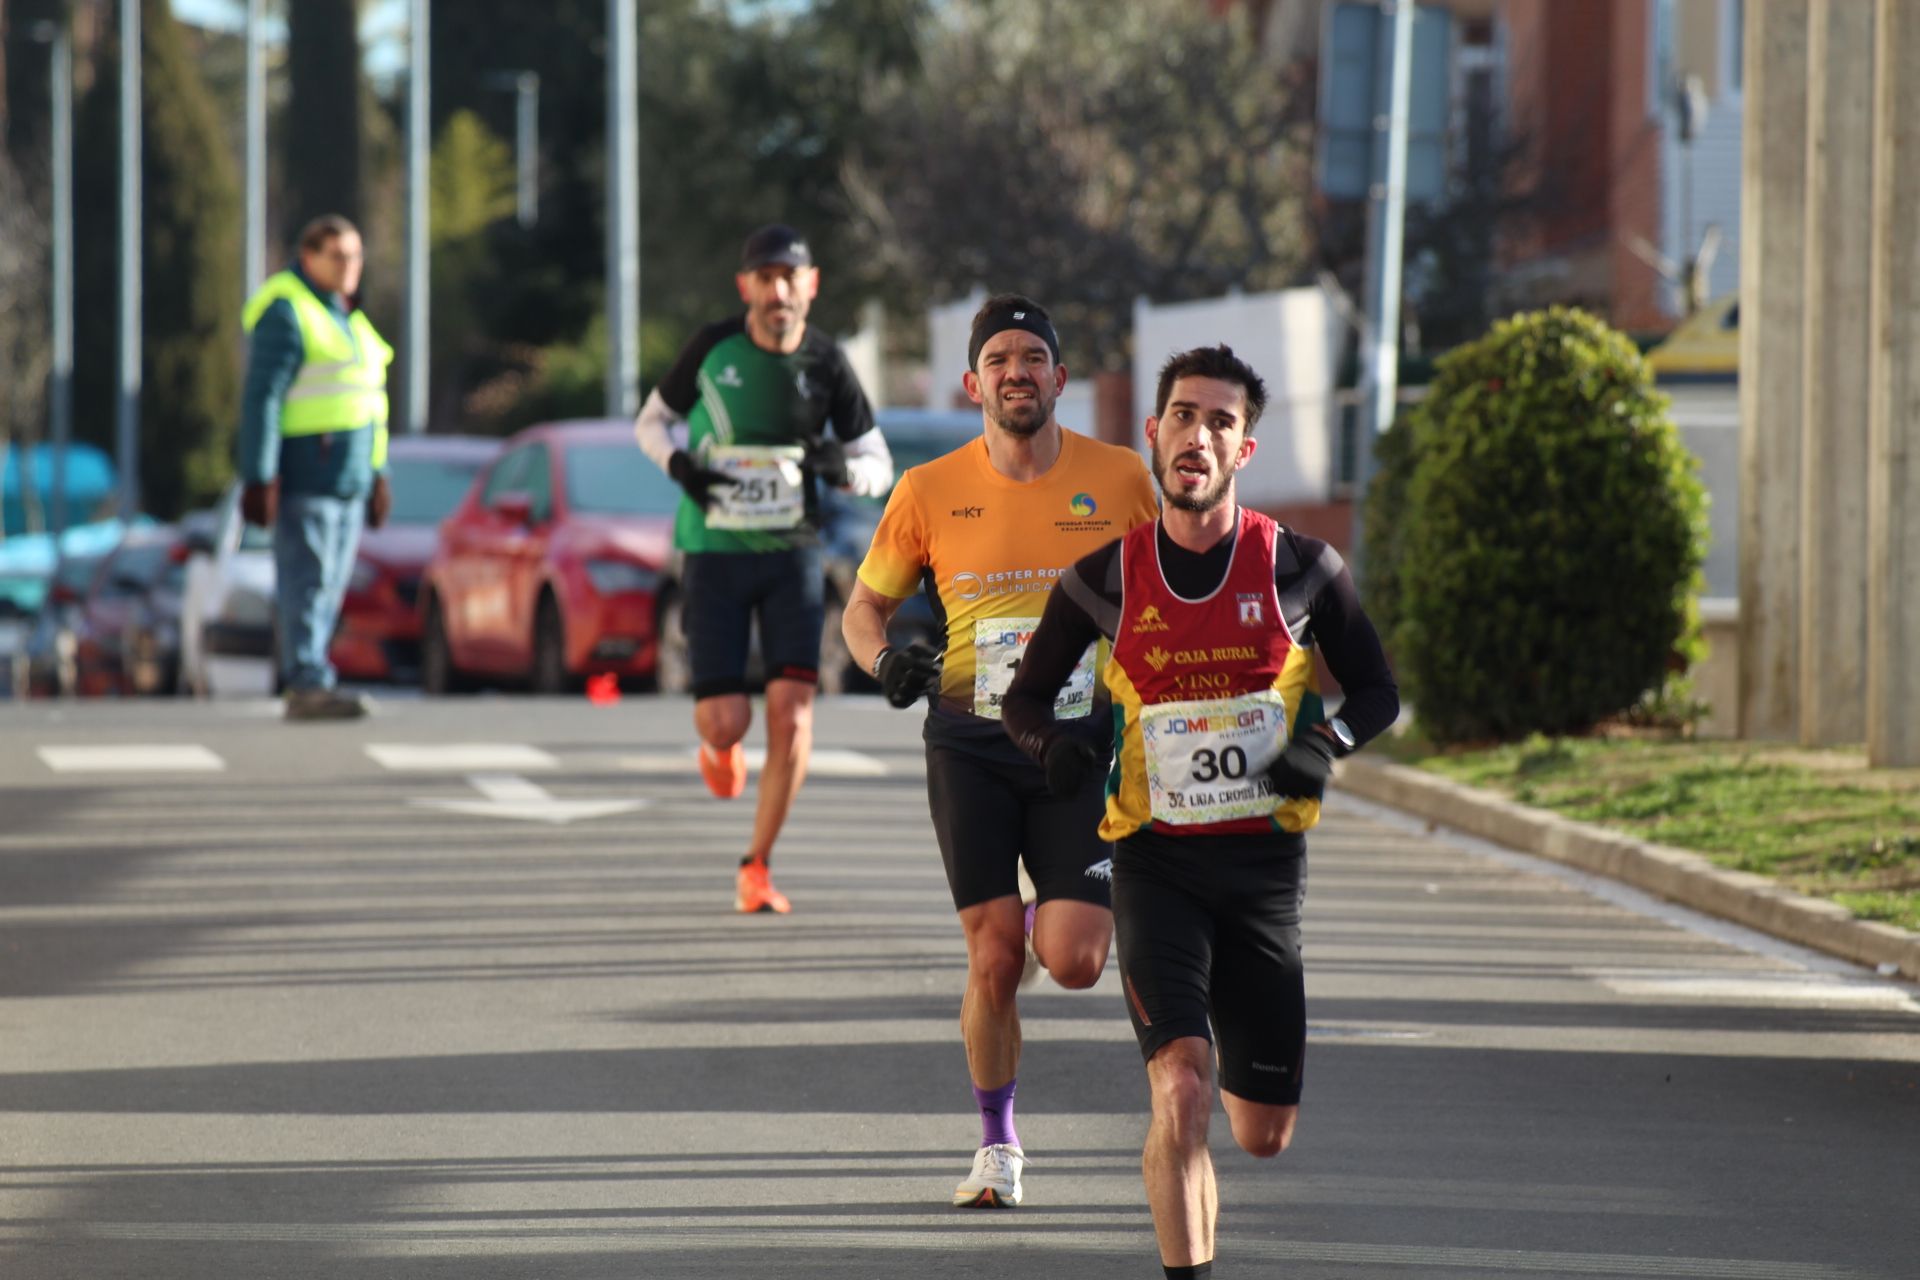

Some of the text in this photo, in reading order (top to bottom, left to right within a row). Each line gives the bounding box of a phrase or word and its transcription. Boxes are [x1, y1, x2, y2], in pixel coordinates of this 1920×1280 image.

[729, 477, 779, 504] 251
[986, 569, 1033, 583] ESTER
[1174, 646, 1259, 665] CAJA RURAL
[1174, 671, 1230, 690] VINO
[1164, 708, 1265, 734] JOMISAGA
[1191, 745, 1248, 783] 30
[1168, 791, 1186, 808] 32
